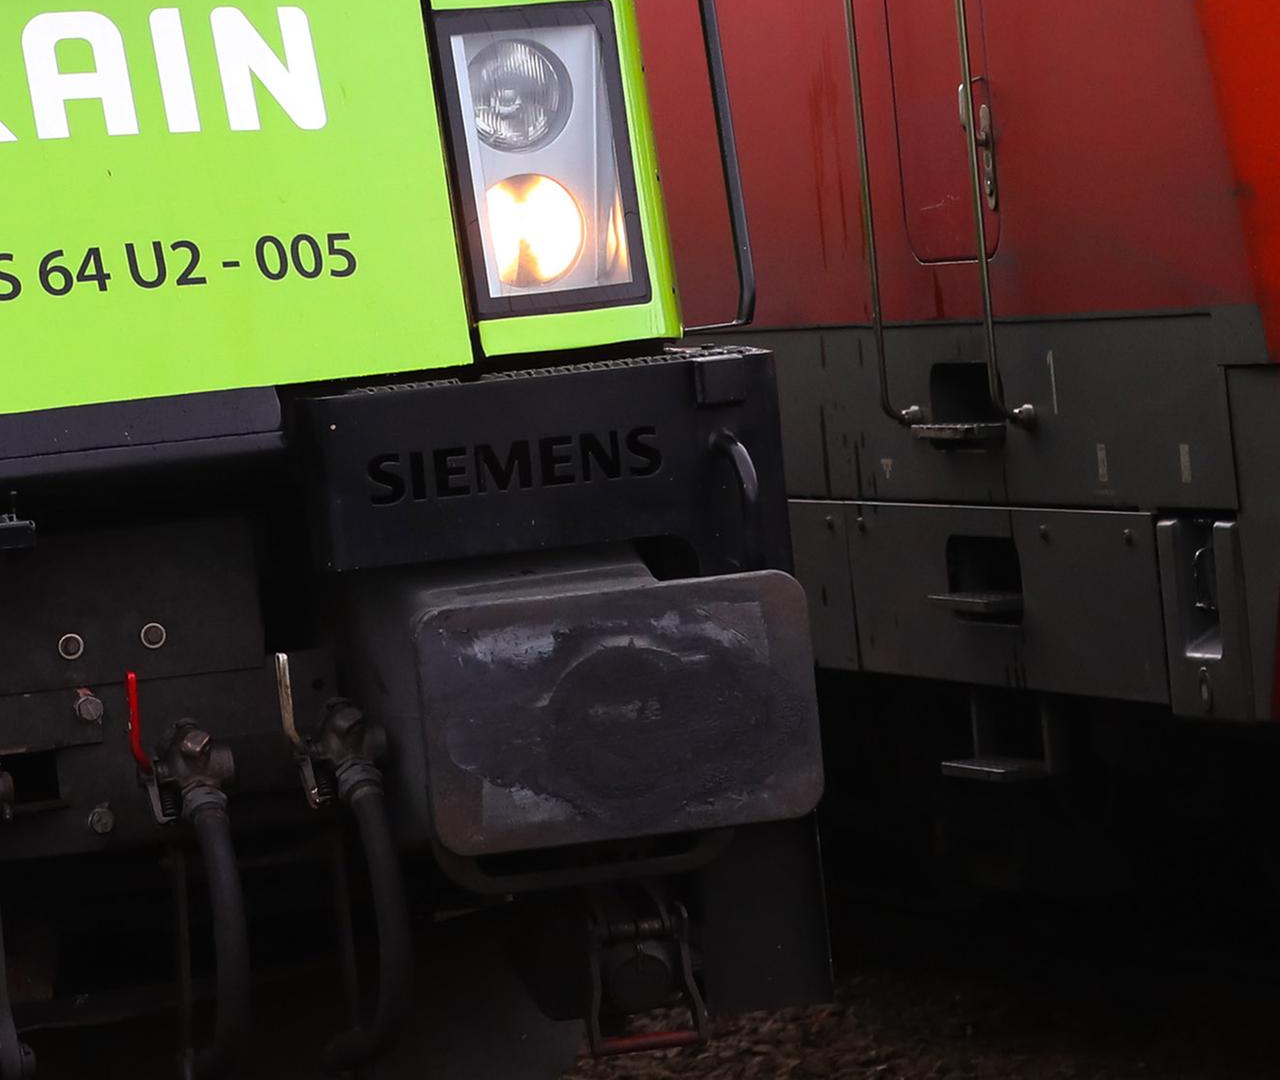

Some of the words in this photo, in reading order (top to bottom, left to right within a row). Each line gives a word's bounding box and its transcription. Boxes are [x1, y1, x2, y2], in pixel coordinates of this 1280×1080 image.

[38, 247, 112, 296] 64
[124, 240, 207, 289] U2
[367, 425, 663, 507] SIEMENS
